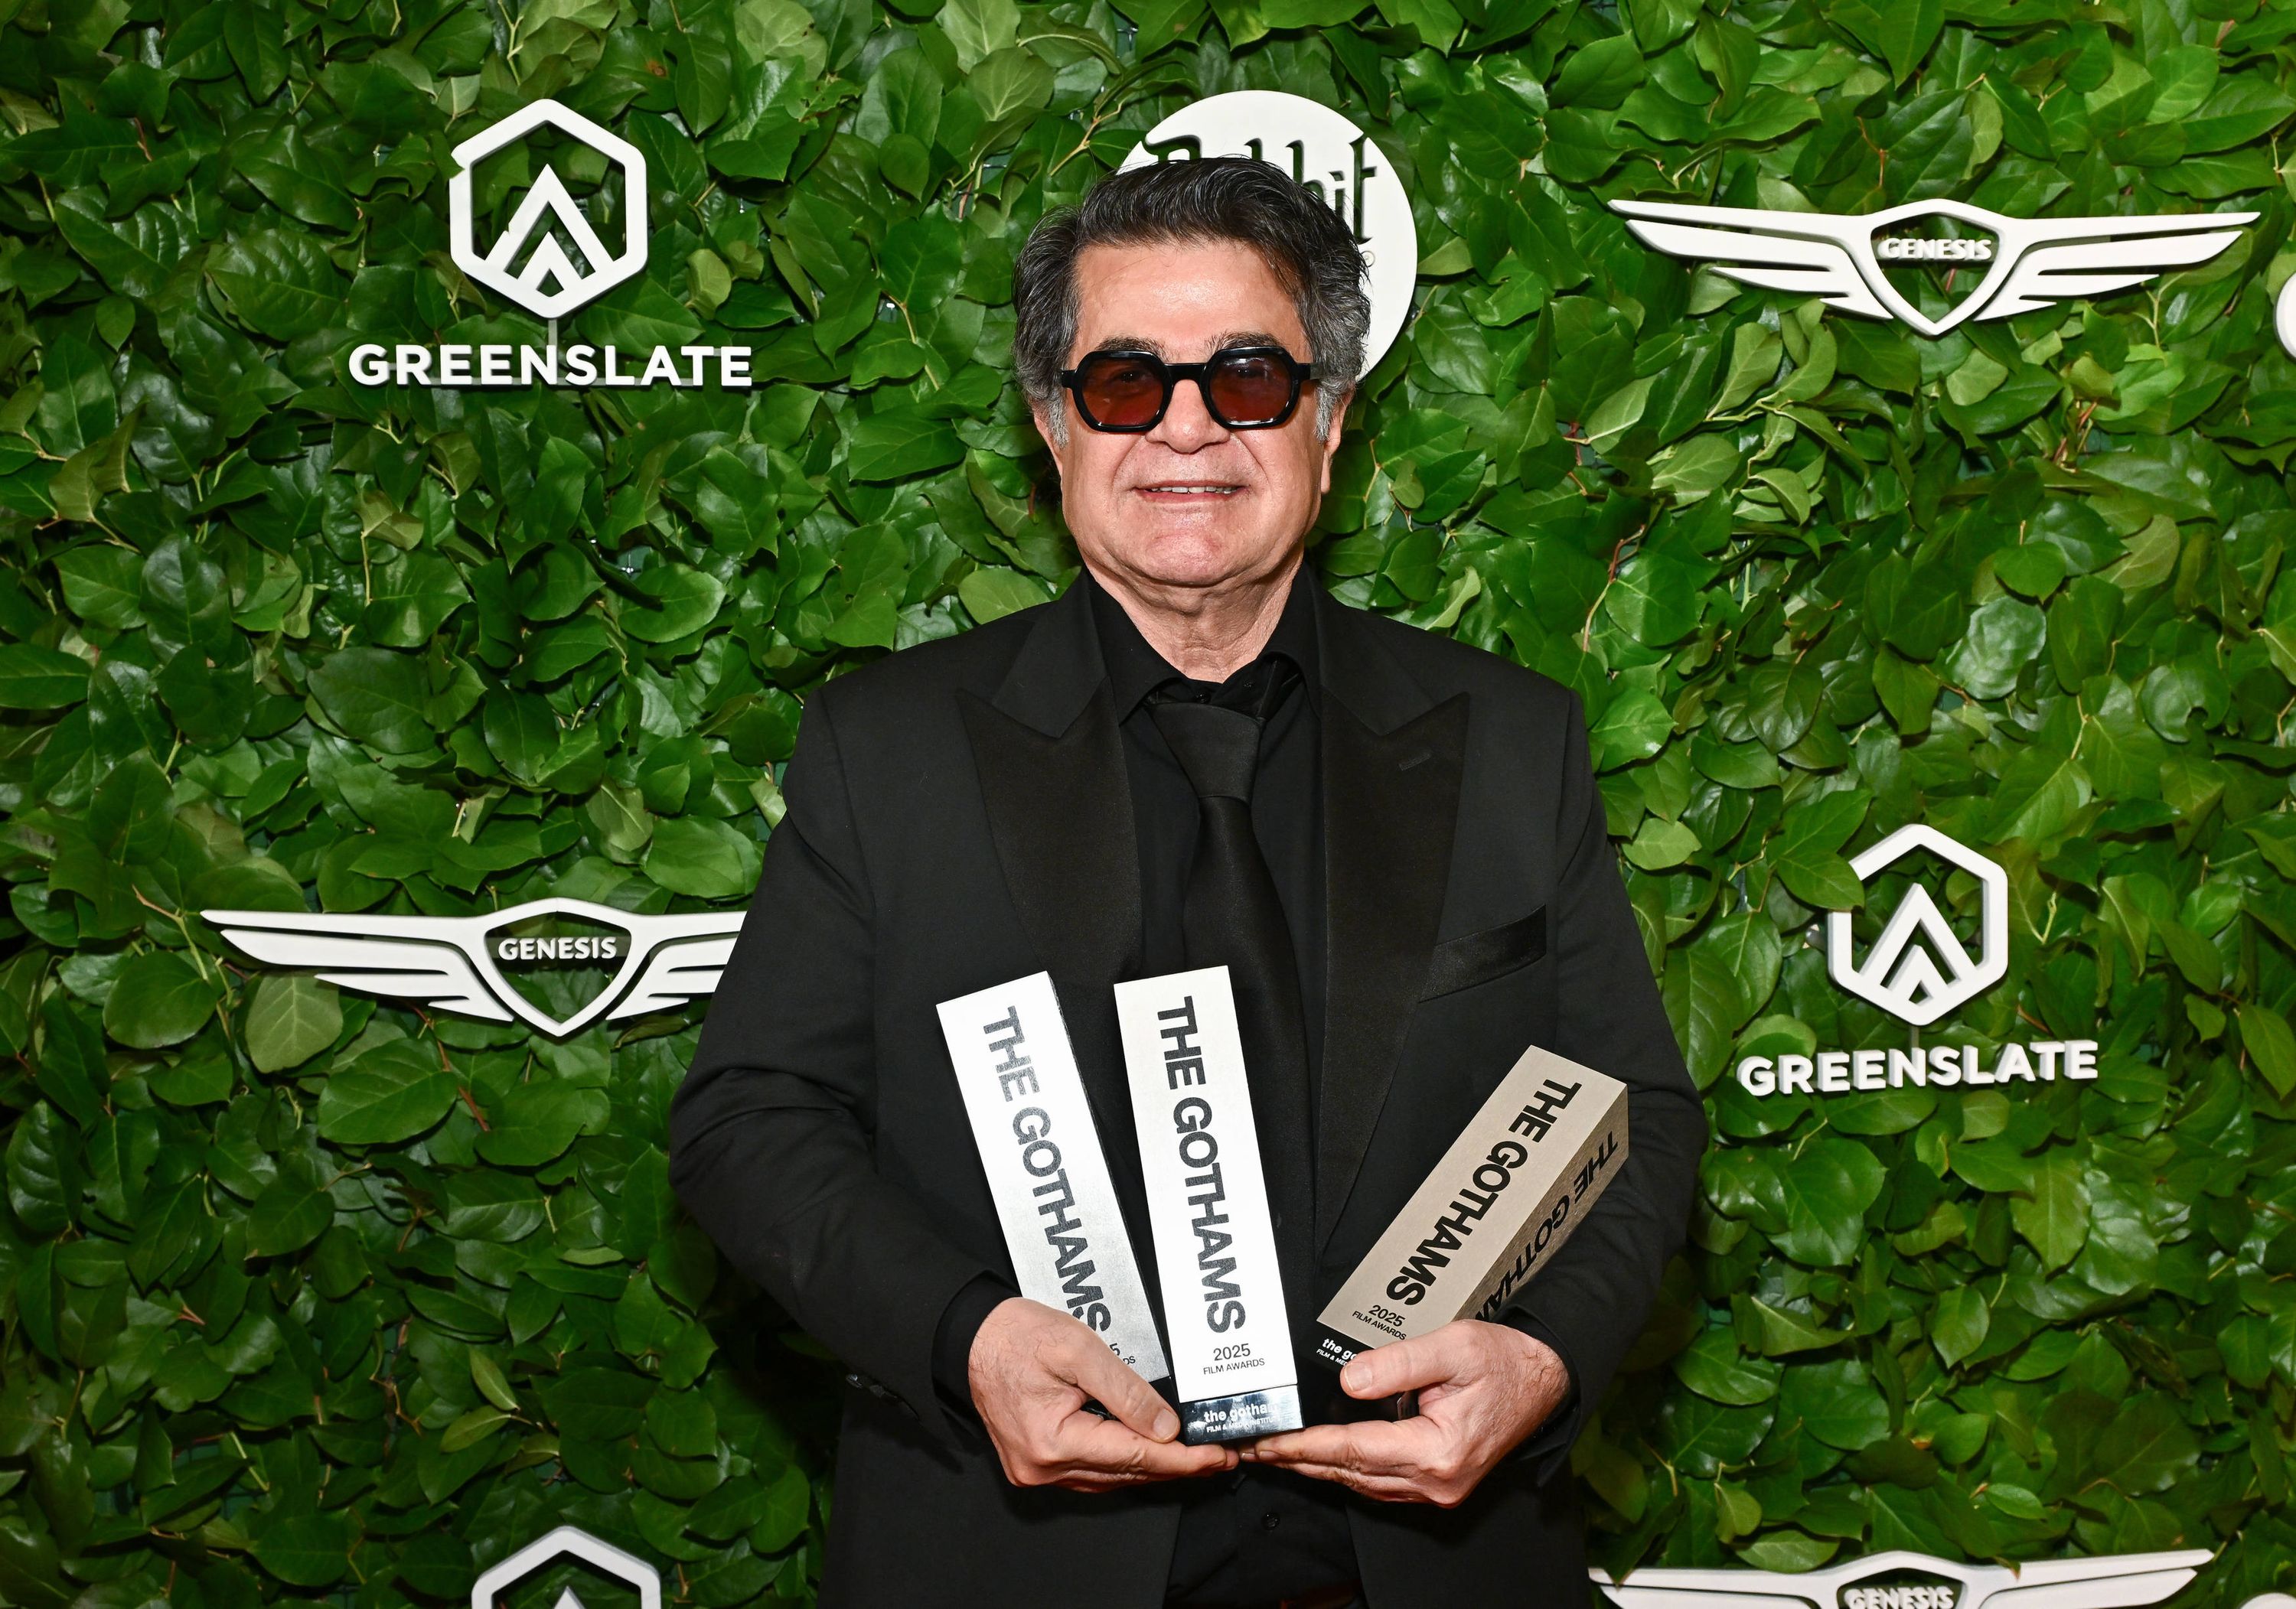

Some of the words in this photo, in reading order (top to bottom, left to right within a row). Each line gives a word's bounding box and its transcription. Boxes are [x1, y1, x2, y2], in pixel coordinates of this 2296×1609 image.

[1877, 237, 1991, 259] GENESIS
[348, 344, 752, 386] GREENSLATE
[498, 936, 617, 960] GENESIS
[1157, 995, 1206, 1090] THE
[1737, 1039, 2099, 1096] GREENSLATE
[1508, 1079, 1582, 1143] THE
[983, 1005, 1040, 1102] THE
[1013, 1106, 1111, 1333] GOTHAMS
[1573, 1131, 1619, 1204] THE
[1173, 1096, 1246, 1334] GOTHAMS
[1386, 1140, 1528, 1306] GOTHAMS
[1475, 1194, 1570, 1322] GOTHA
[1352, 1311, 1372, 1324] FILM
[1371, 1320, 1407, 1340] AWARDS
[1368, 1304, 1405, 1327] 2025
[1213, 1344, 1251, 1361] 2025
[1316, 1349, 1330, 1359] FILM
[1322, 1338, 1342, 1353] the
[1203, 1364, 1225, 1375] FILM
[1226, 1358, 1265, 1371] AWARDS
[1203, 1410, 1227, 1423] the
[1844, 1585, 1954, 1609] GENESIS
